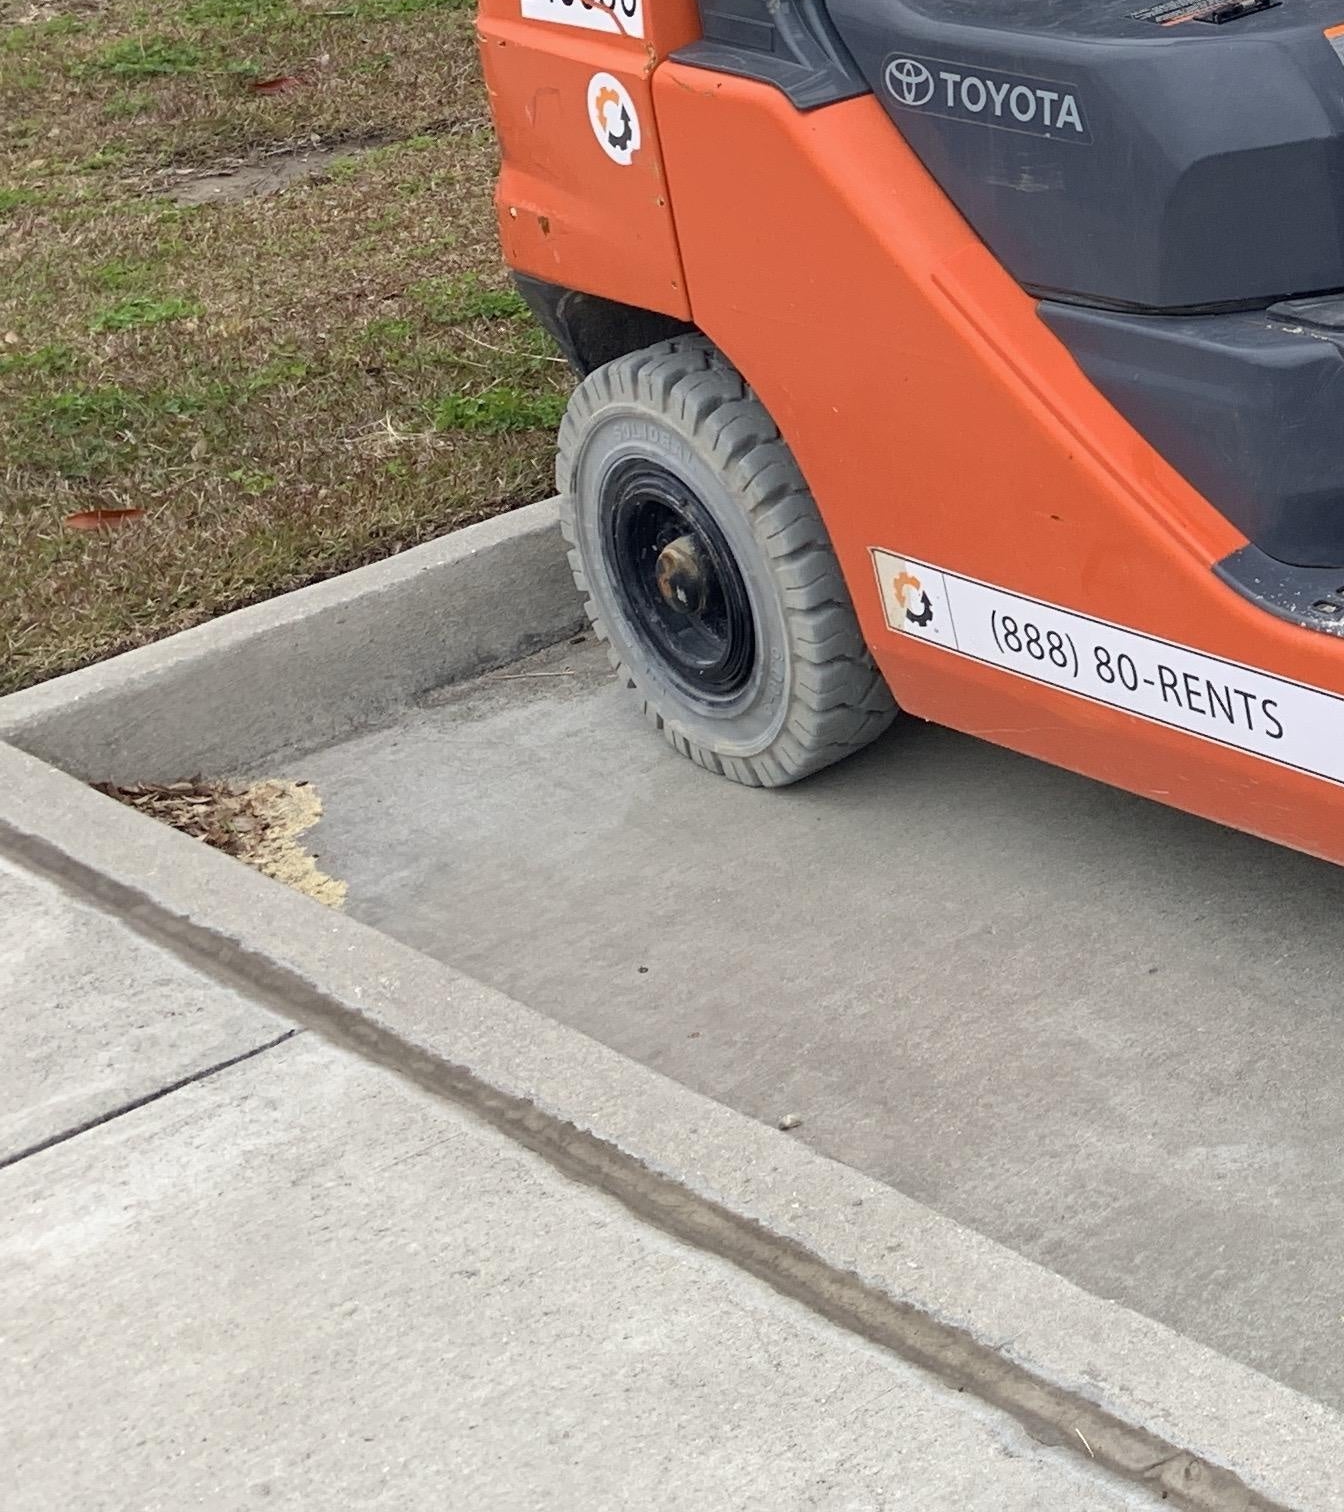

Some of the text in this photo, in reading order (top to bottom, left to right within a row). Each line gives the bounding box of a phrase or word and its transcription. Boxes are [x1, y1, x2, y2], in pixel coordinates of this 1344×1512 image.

[939, 71, 1084, 132] TOYOTA
[991, 609, 1284, 739] (888) 80-RENTS
